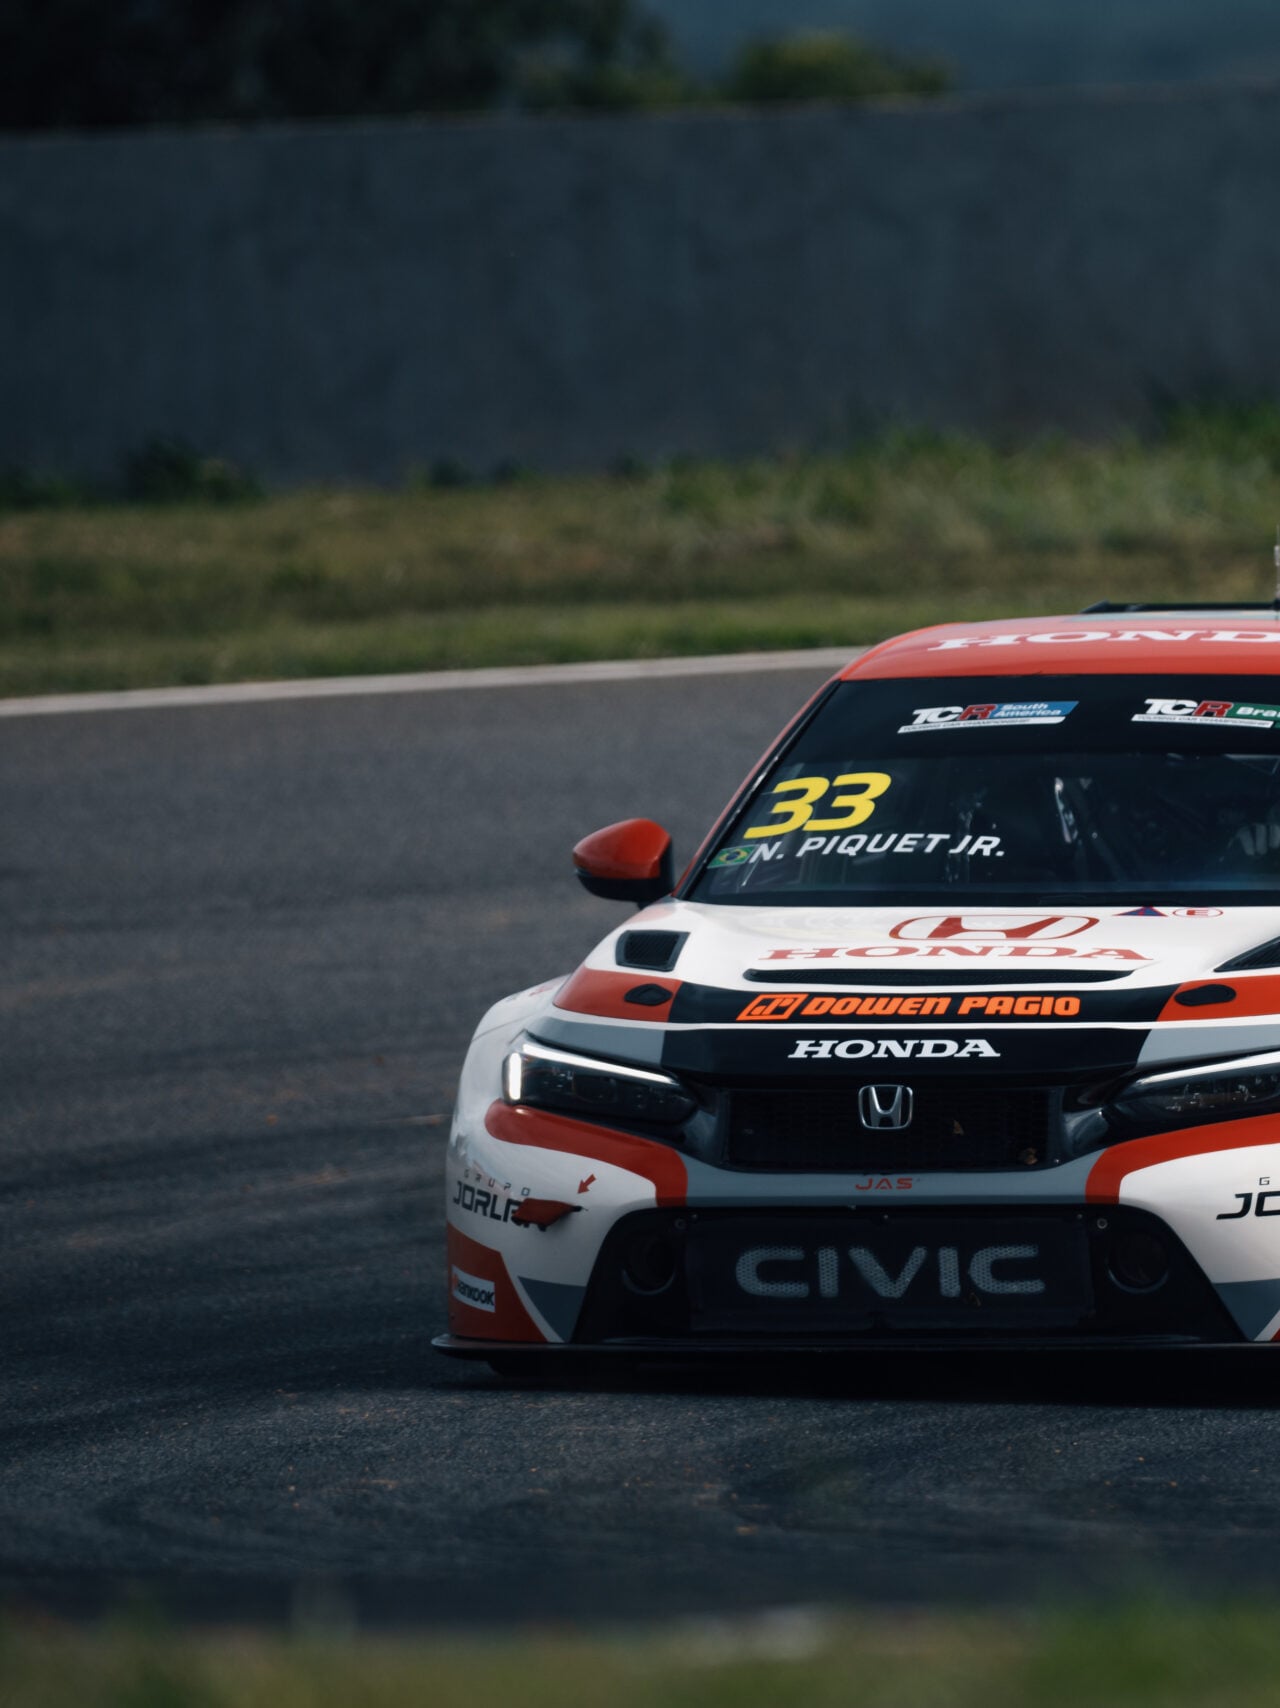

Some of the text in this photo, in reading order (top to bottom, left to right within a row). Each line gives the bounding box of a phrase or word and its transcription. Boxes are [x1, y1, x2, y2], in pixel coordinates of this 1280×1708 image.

[912, 703, 1050, 725] TCR South
[993, 709, 1062, 718] America
[1145, 698, 1233, 717] TCR
[743, 772, 892, 839] 33
[749, 833, 1005, 864] N. PIQUET JR.
[758, 945, 1153, 961] HONDA
[800, 996, 1081, 1017] DOWEN PAGIO
[787, 1039, 1000, 1059] HONDA
[855, 1177, 913, 1190] JAS
[452, 1180, 548, 1232] JORLA
[735, 1244, 1046, 1299] CIVIC
